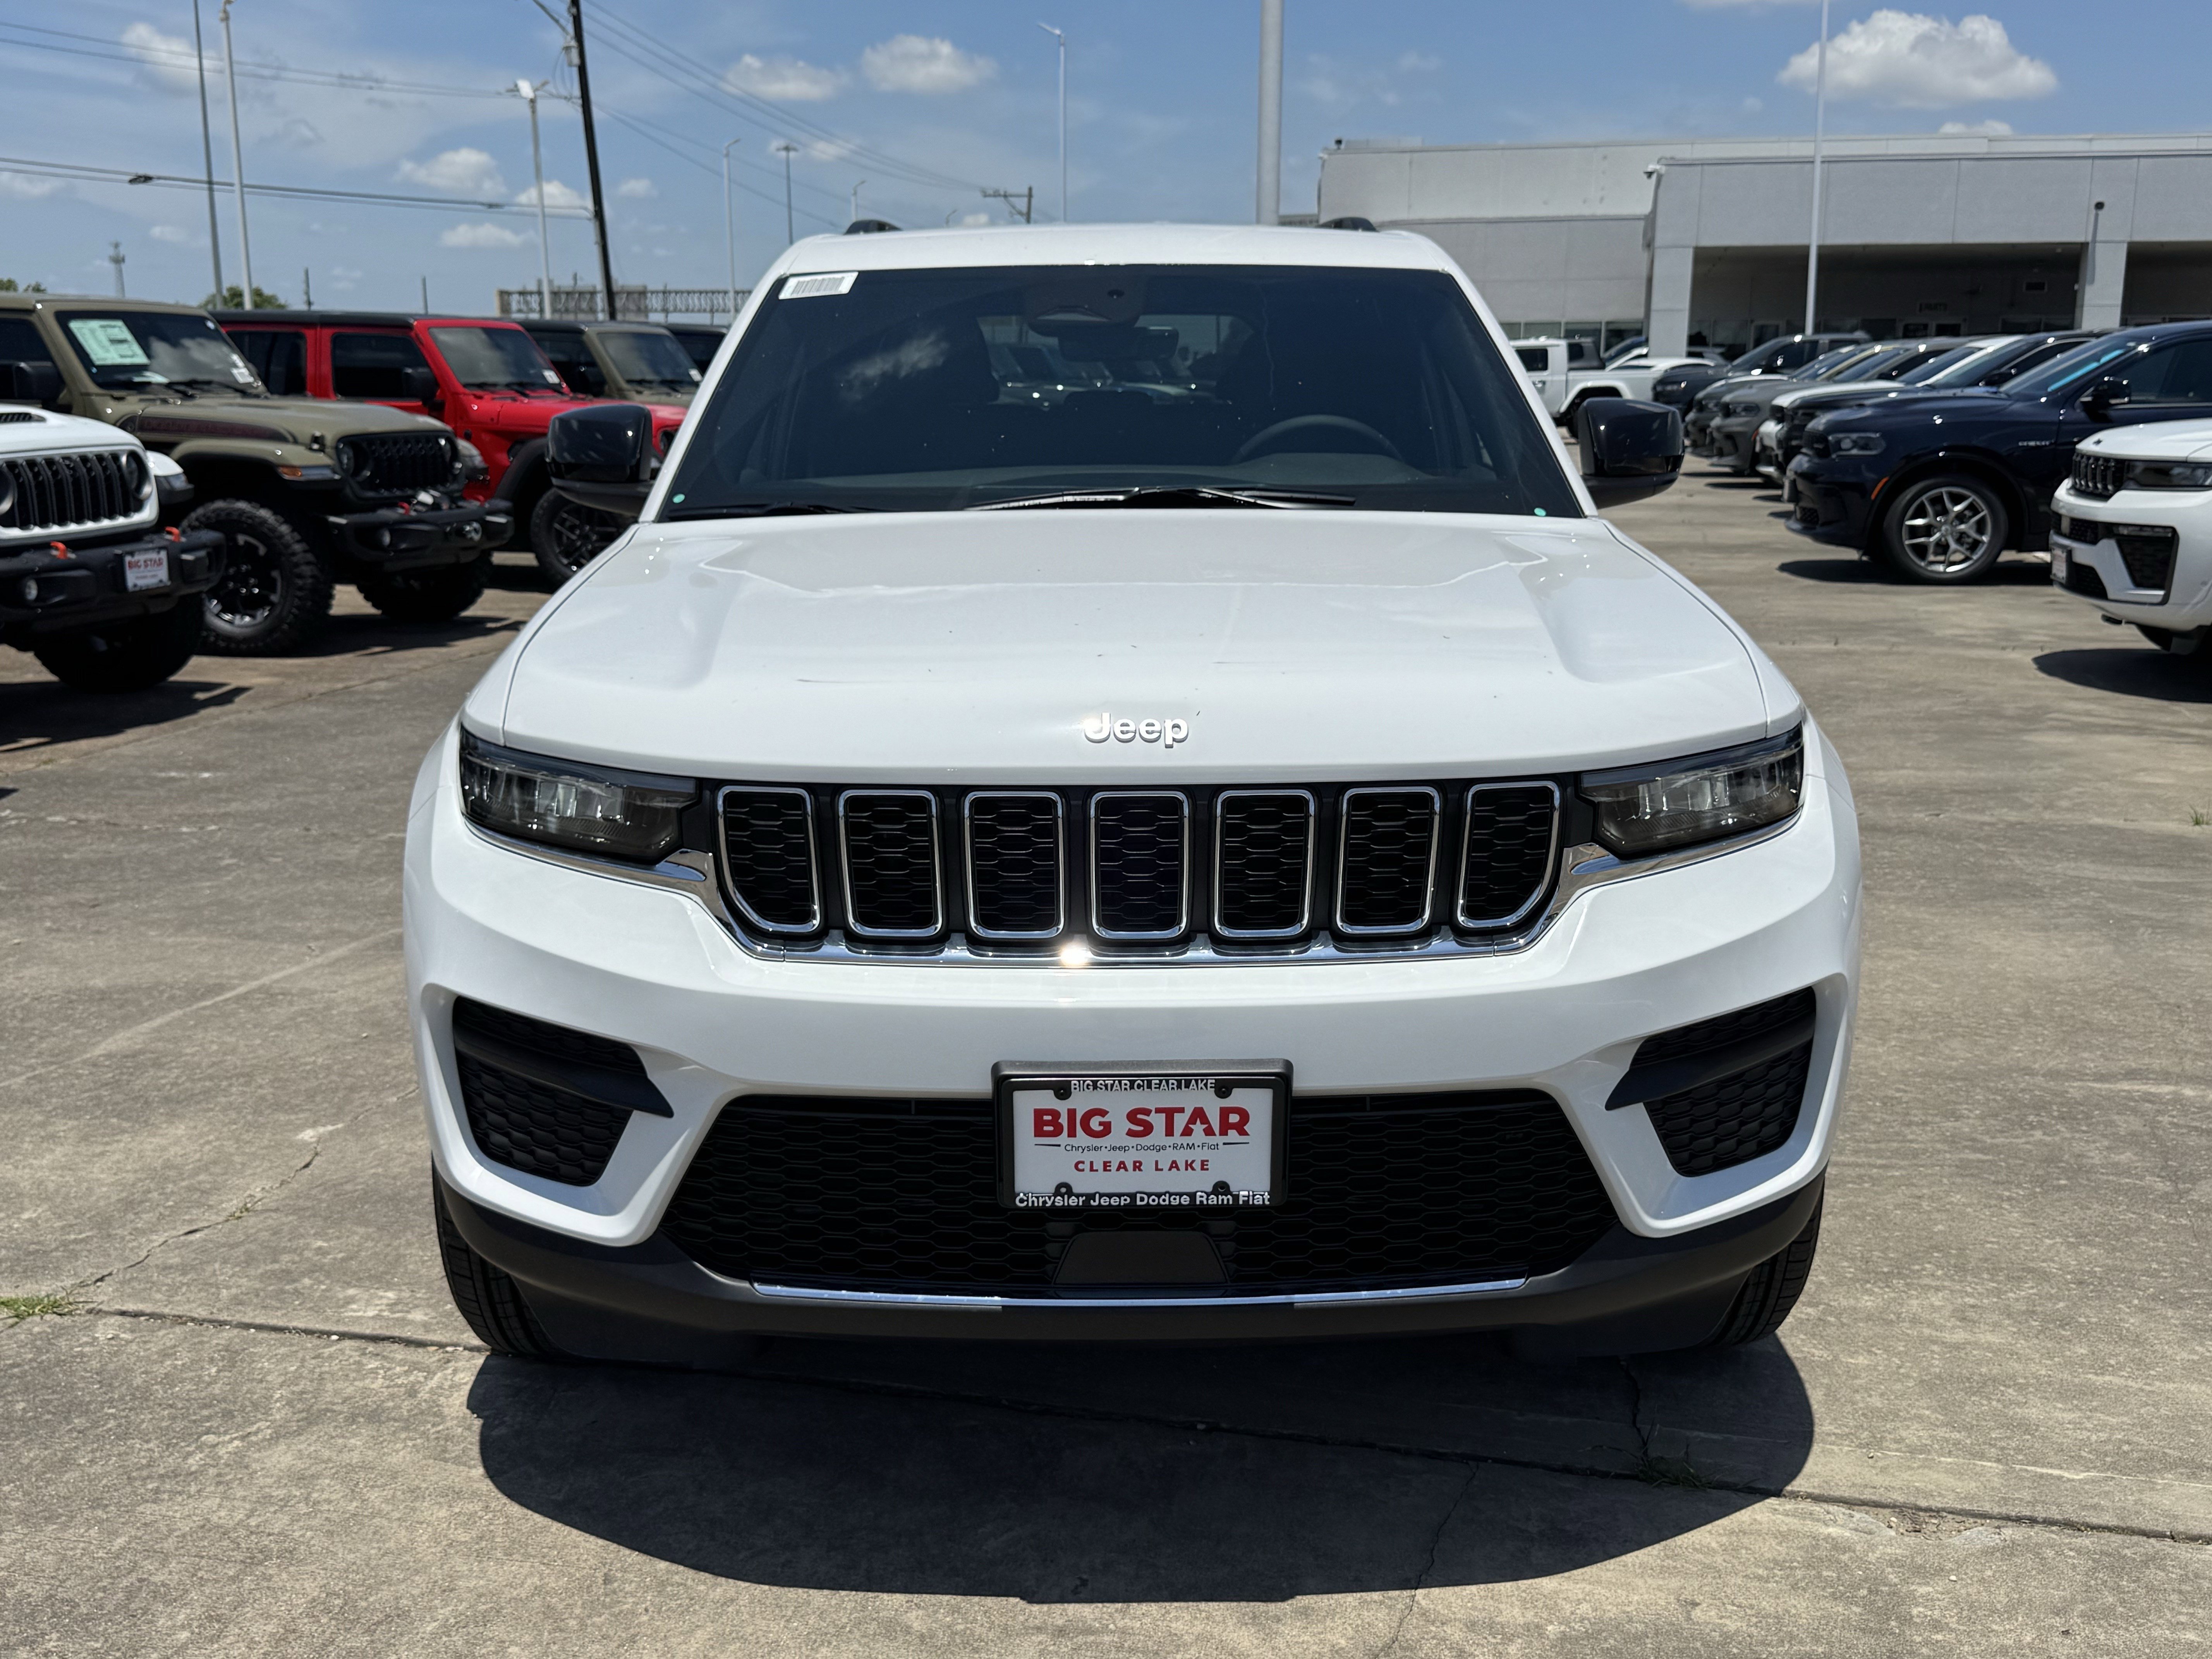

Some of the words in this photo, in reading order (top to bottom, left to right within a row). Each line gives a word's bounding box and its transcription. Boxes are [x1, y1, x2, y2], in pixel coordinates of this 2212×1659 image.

[1084, 712, 1188, 748] Jeep
[1071, 1080, 1093, 1091] BIG
[1097, 1080, 1130, 1091] STAR
[1134, 1080, 1177, 1091] CLEAR
[1182, 1079, 1215, 1091] LAKE
[1034, 1108, 1112, 1139] BIG
[1125, 1106, 1250, 1138] STAR
[1074, 1160, 1143, 1172] CLEAR
[1155, 1159, 1209, 1172] LAKE
[1015, 1192, 1085, 1207] Chrysler
[1091, 1193, 1131, 1206] Jeep
[1136, 1193, 1190, 1205] Dodge
[1196, 1192, 1233, 1205] Ram
[1239, 1191, 1270, 1205] Fiat
